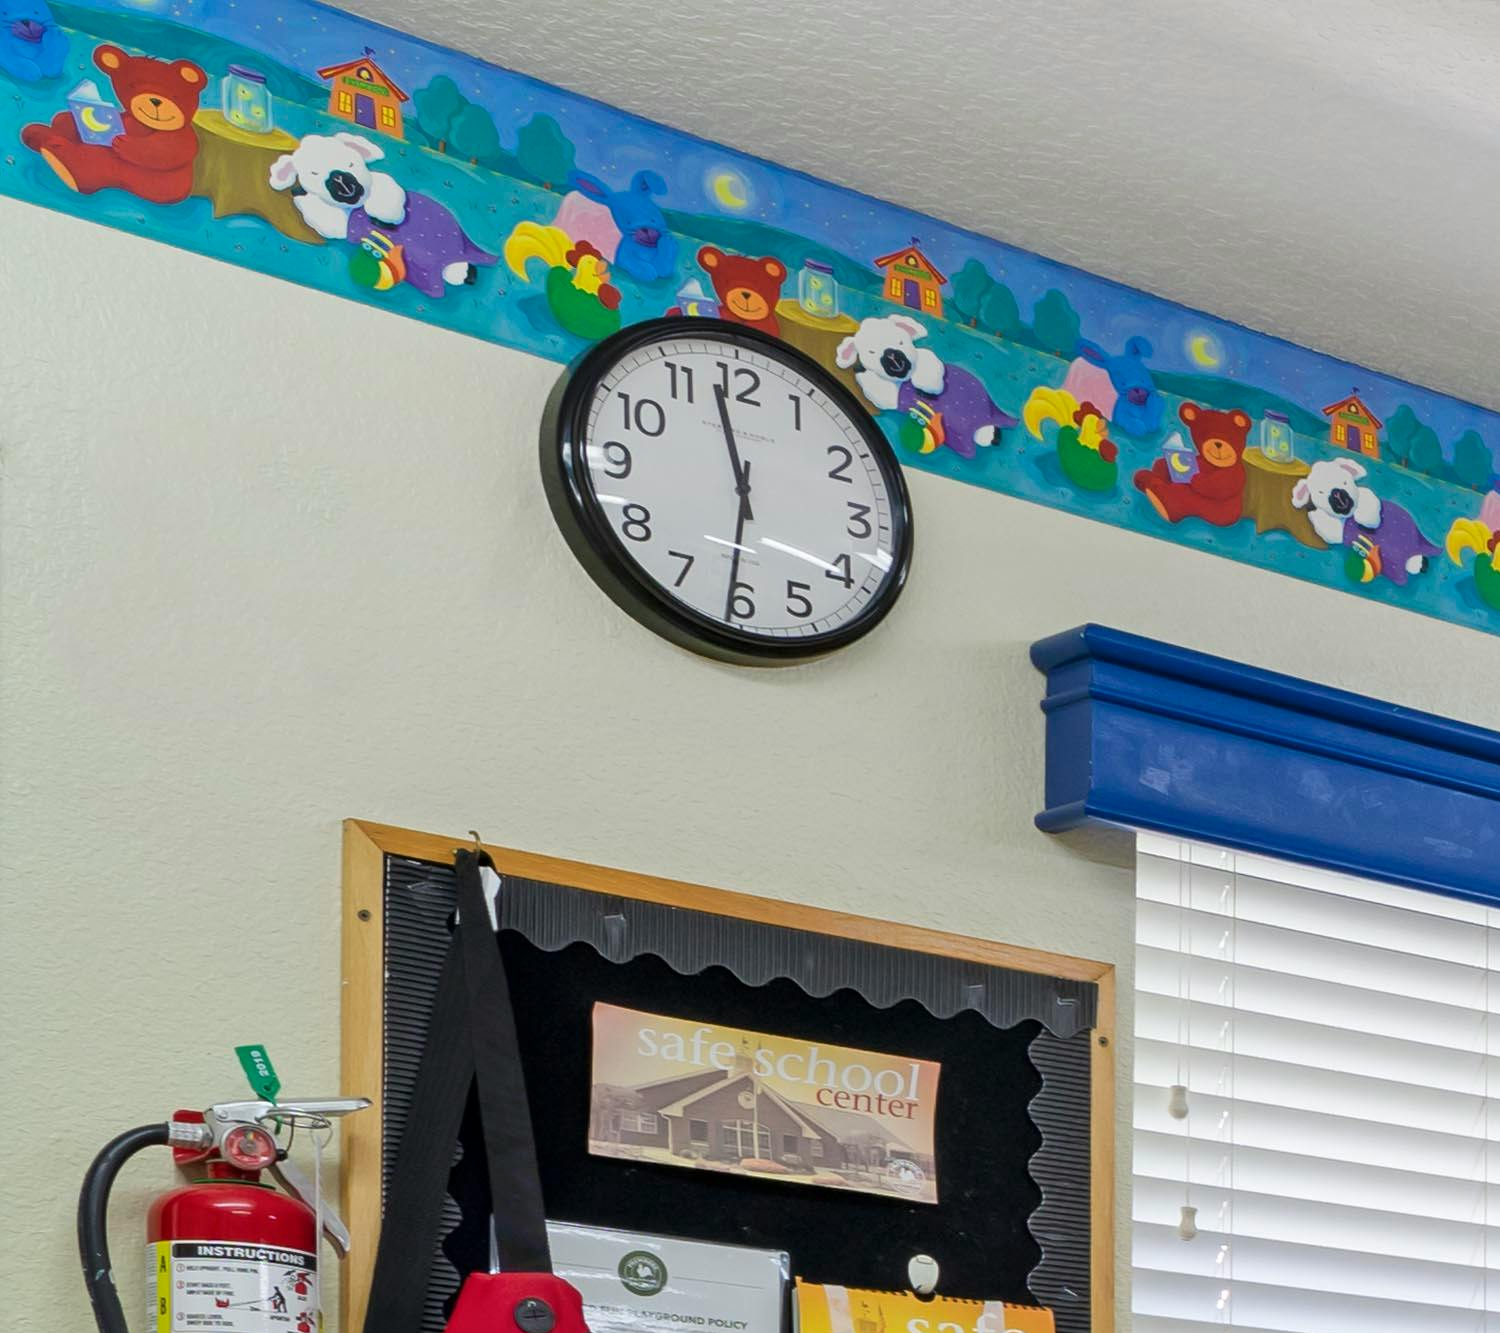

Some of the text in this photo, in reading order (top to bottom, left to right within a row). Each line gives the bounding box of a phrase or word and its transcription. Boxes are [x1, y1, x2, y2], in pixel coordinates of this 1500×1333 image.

[664, 361, 694, 404] 11
[716, 361, 761, 407] 12
[617, 391, 666, 438] 10
[788, 394, 802, 431] 1
[602, 440, 632, 480] 9
[826, 445, 853, 484] 2
[622, 503, 652, 542] 8
[846, 501, 872, 539] 3
[668, 550, 695, 588] 7
[825, 553, 855, 589] 4
[730, 582, 756, 620] 6
[786, 579, 813, 618] 5
[637, 1027, 920, 1101] safe school
[816, 1087, 919, 1120] center
[159, 1256, 167, 1273] A
[197, 1246, 305, 1266] INSTRUCTIONS
[708, 1317, 748, 1330] POLICY
